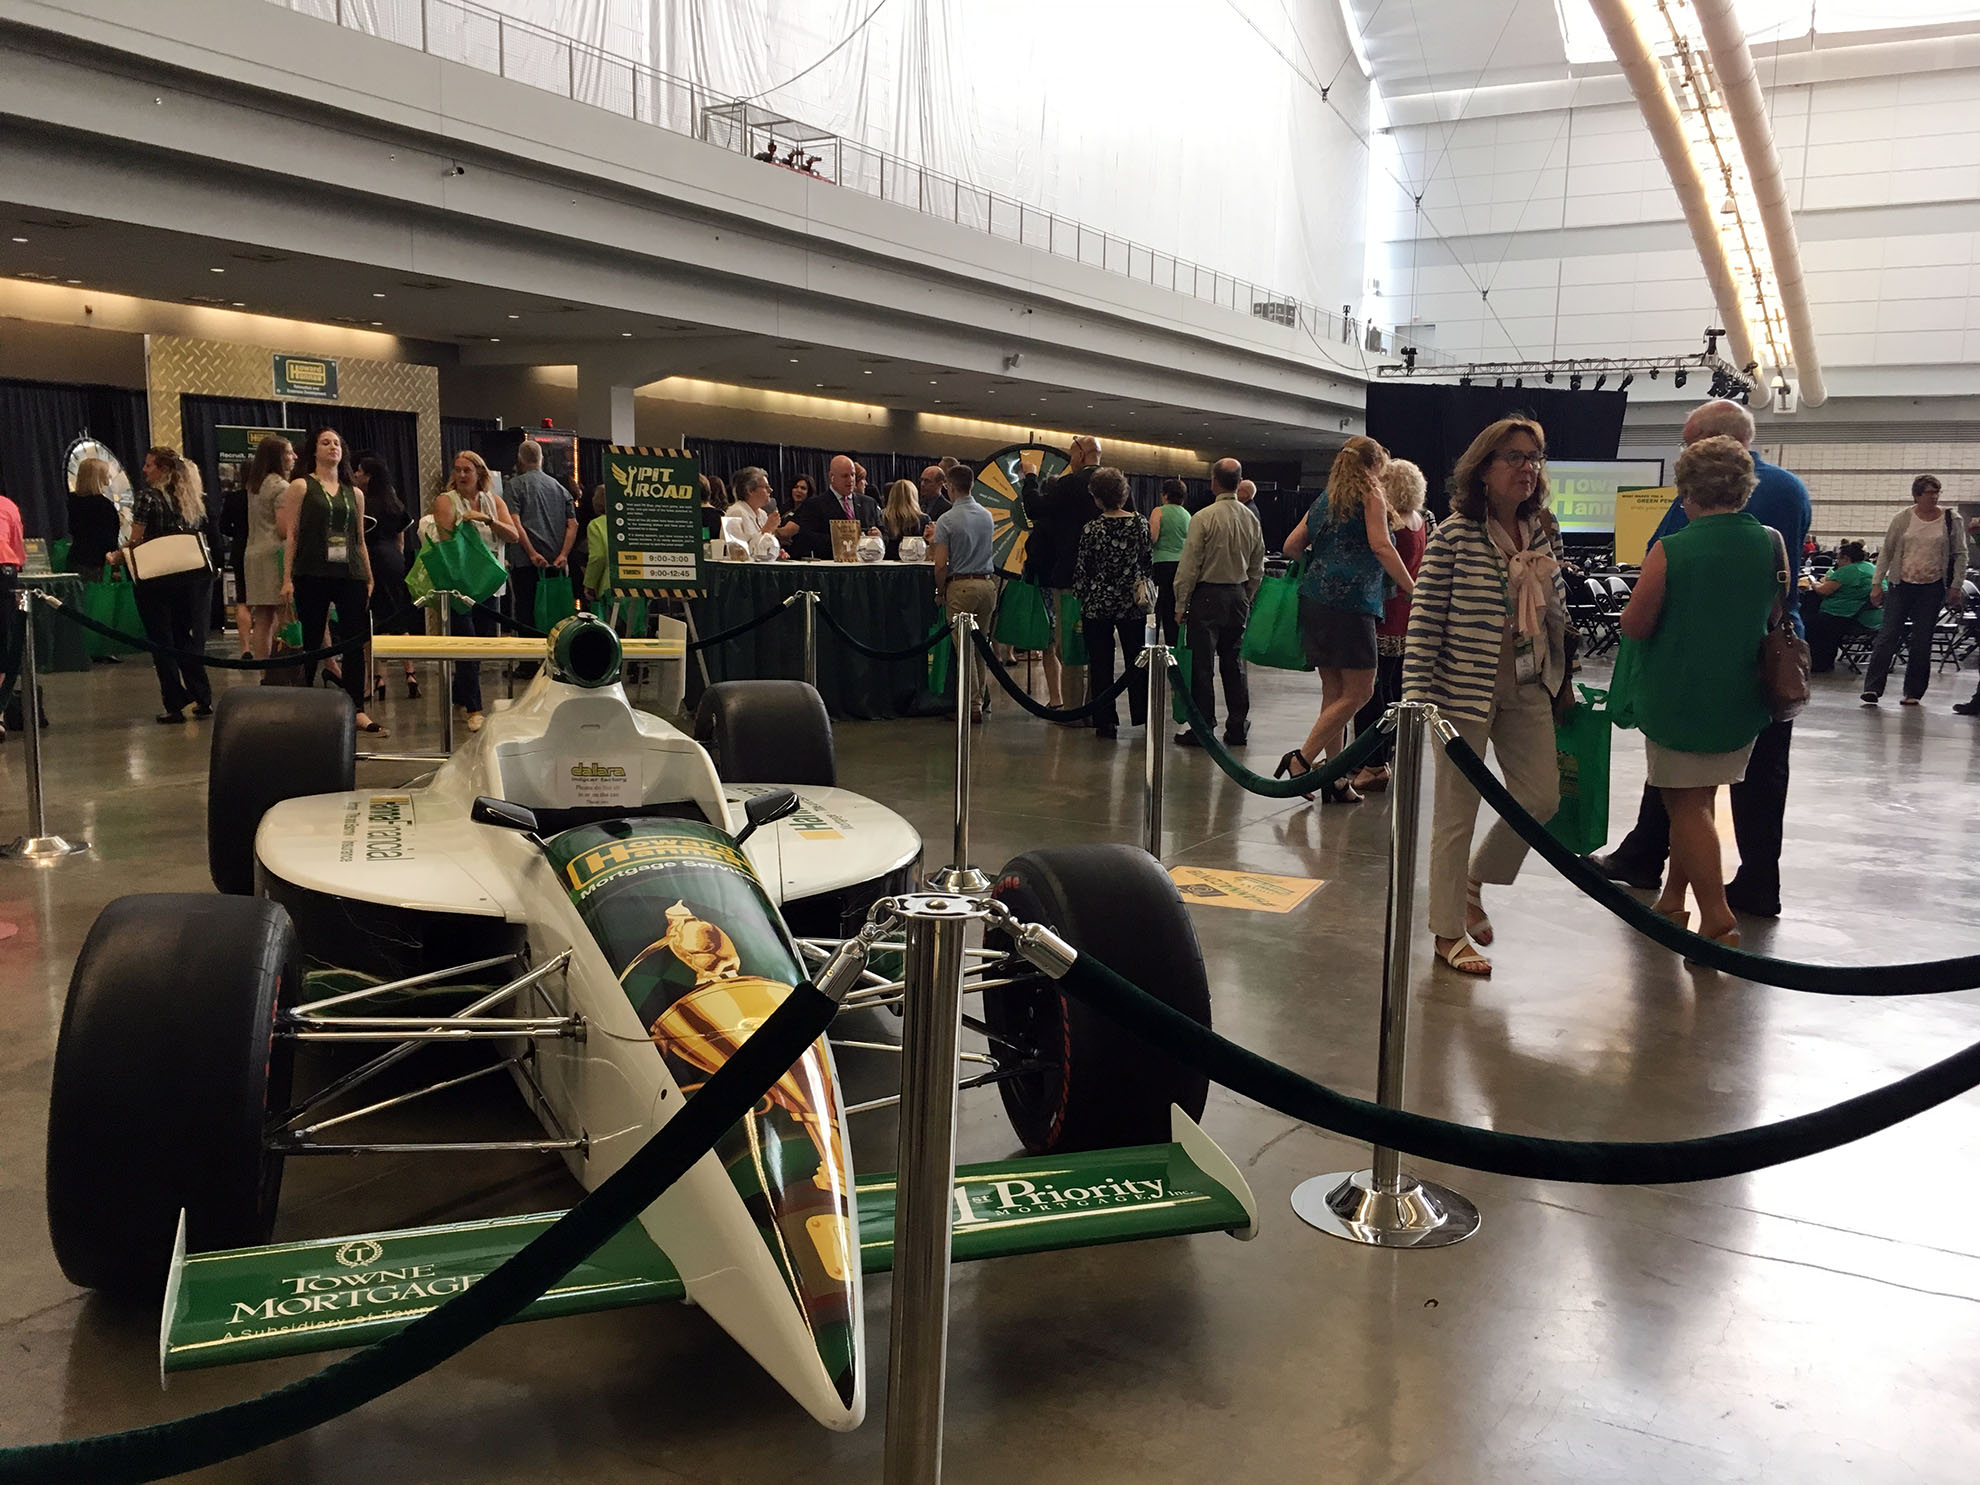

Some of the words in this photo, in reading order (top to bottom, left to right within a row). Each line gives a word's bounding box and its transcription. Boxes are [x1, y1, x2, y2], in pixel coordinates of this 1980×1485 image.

[637, 467, 674, 482] PIT
[635, 483, 693, 499] ROAD
[648, 554, 689, 563] 9:00-3:00
[649, 569, 690, 577] 9:00-12:45
[571, 762, 626, 777] dallara
[788, 807, 834, 831] Han
[580, 860, 677, 900] Mortgage
[988, 1177, 1164, 1210] Priority
[282, 1263, 435, 1295] TOWNE
[240, 1316, 346, 1338] Subsidiary
